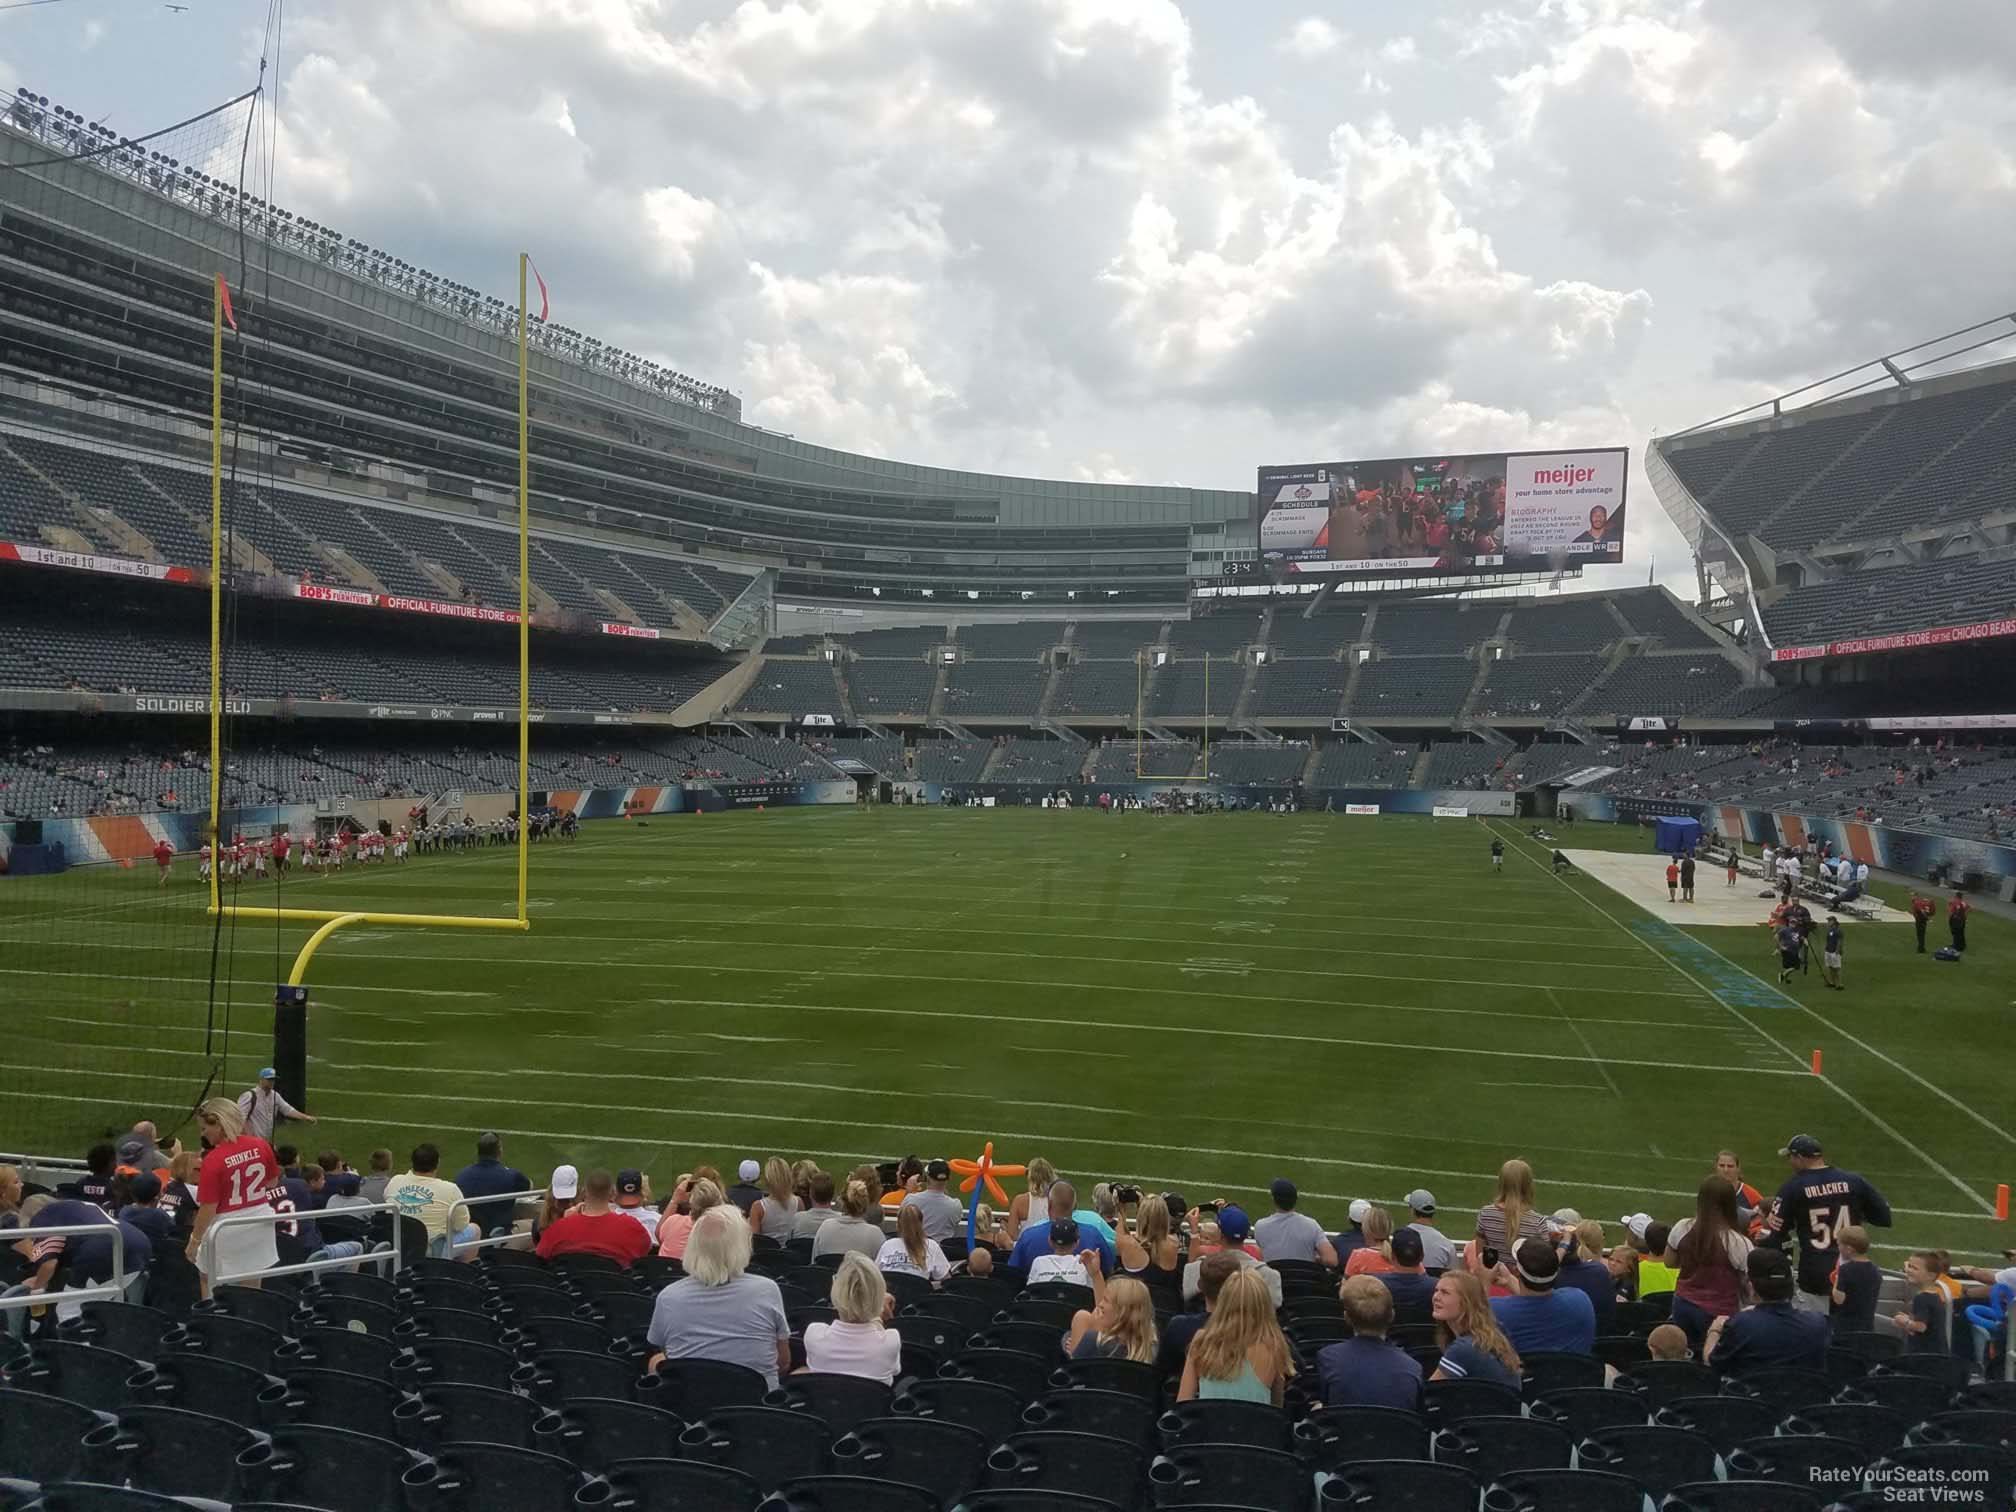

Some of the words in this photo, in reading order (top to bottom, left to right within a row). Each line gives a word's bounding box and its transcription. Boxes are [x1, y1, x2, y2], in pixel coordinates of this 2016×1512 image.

[1534, 464, 1595, 487] meijer
[1515, 490, 1531, 498] your
[1533, 488, 1553, 496] home
[1555, 487, 1573, 495] store
[1576, 486, 1613, 495] advantage
[1282, 501, 1318, 509] SCHEDULE
[1511, 508, 1557, 516] BIOGRAPHY
[37, 550, 54, 563] 1st
[58, 555, 77, 567] and
[81, 557, 94, 569] 10
[137, 564, 150, 576] 50
[301, 586, 331, 600] BOB'S
[388, 597, 429, 612] OFFICIAL
[431, 602, 477, 618] FURNITURE
[478, 608, 505, 621] STORE
[1836, 642, 1867, 654] OFFICIAL
[1867, 636, 1905, 650] FURNITURE
[1906, 631, 1930, 644] STORE
[1952, 625, 1988, 640] CHICAGO
[1989, 620, 2016, 635] BEARS
[136, 698, 204, 712] SOLDIER
[209, 700, 250, 713] IELD
[473, 711, 497, 720] proven
[1341, 720, 1348, 729] 4
[224, 1147, 261, 1169] SHINKLE
[229, 1162, 266, 1206] 12
[1804, 1181, 1849, 1198] URLACHER
[265, 1185, 288, 1200] STER
[1809, 1205, 1851, 1249] 54
